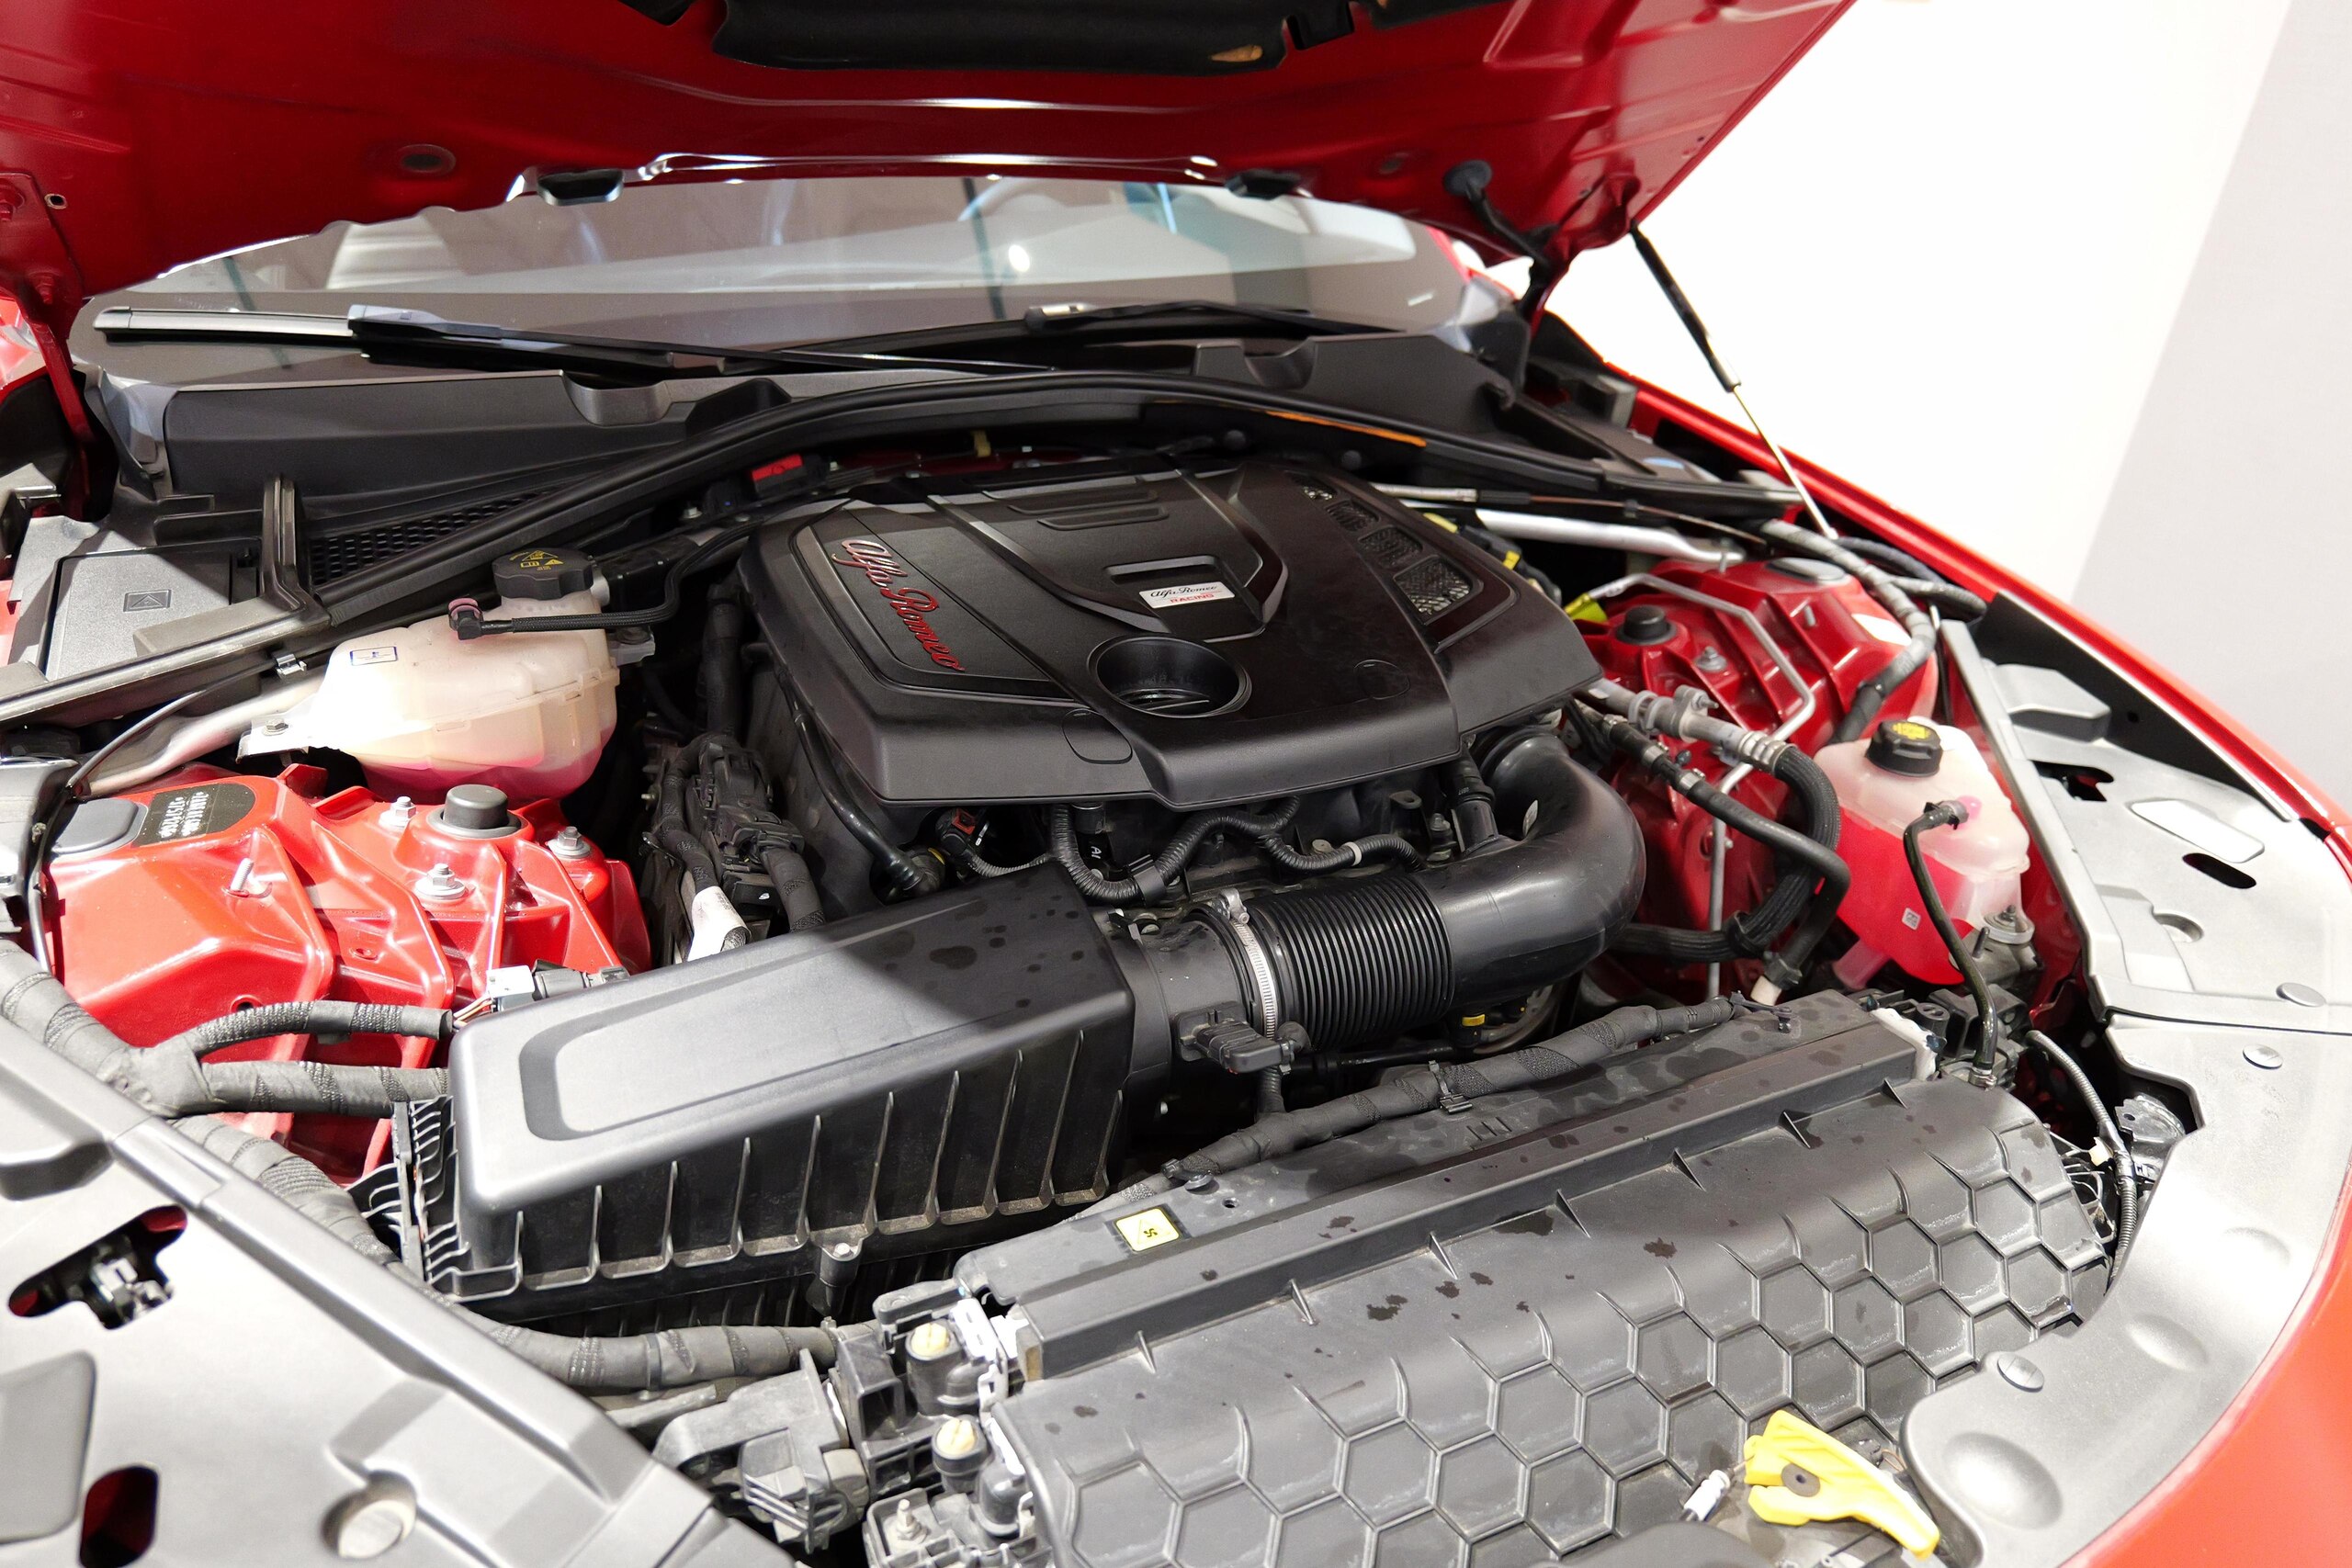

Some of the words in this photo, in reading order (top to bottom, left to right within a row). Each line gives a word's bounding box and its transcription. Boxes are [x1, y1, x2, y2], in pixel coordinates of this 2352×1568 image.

[1150, 588, 1177, 598] Alfa
[1178, 586, 1218, 594] Romeo
[1170, 592, 1215, 604] RACING
[831, 539, 909, 587] Alfa
[879, 587, 967, 671] Romeo
